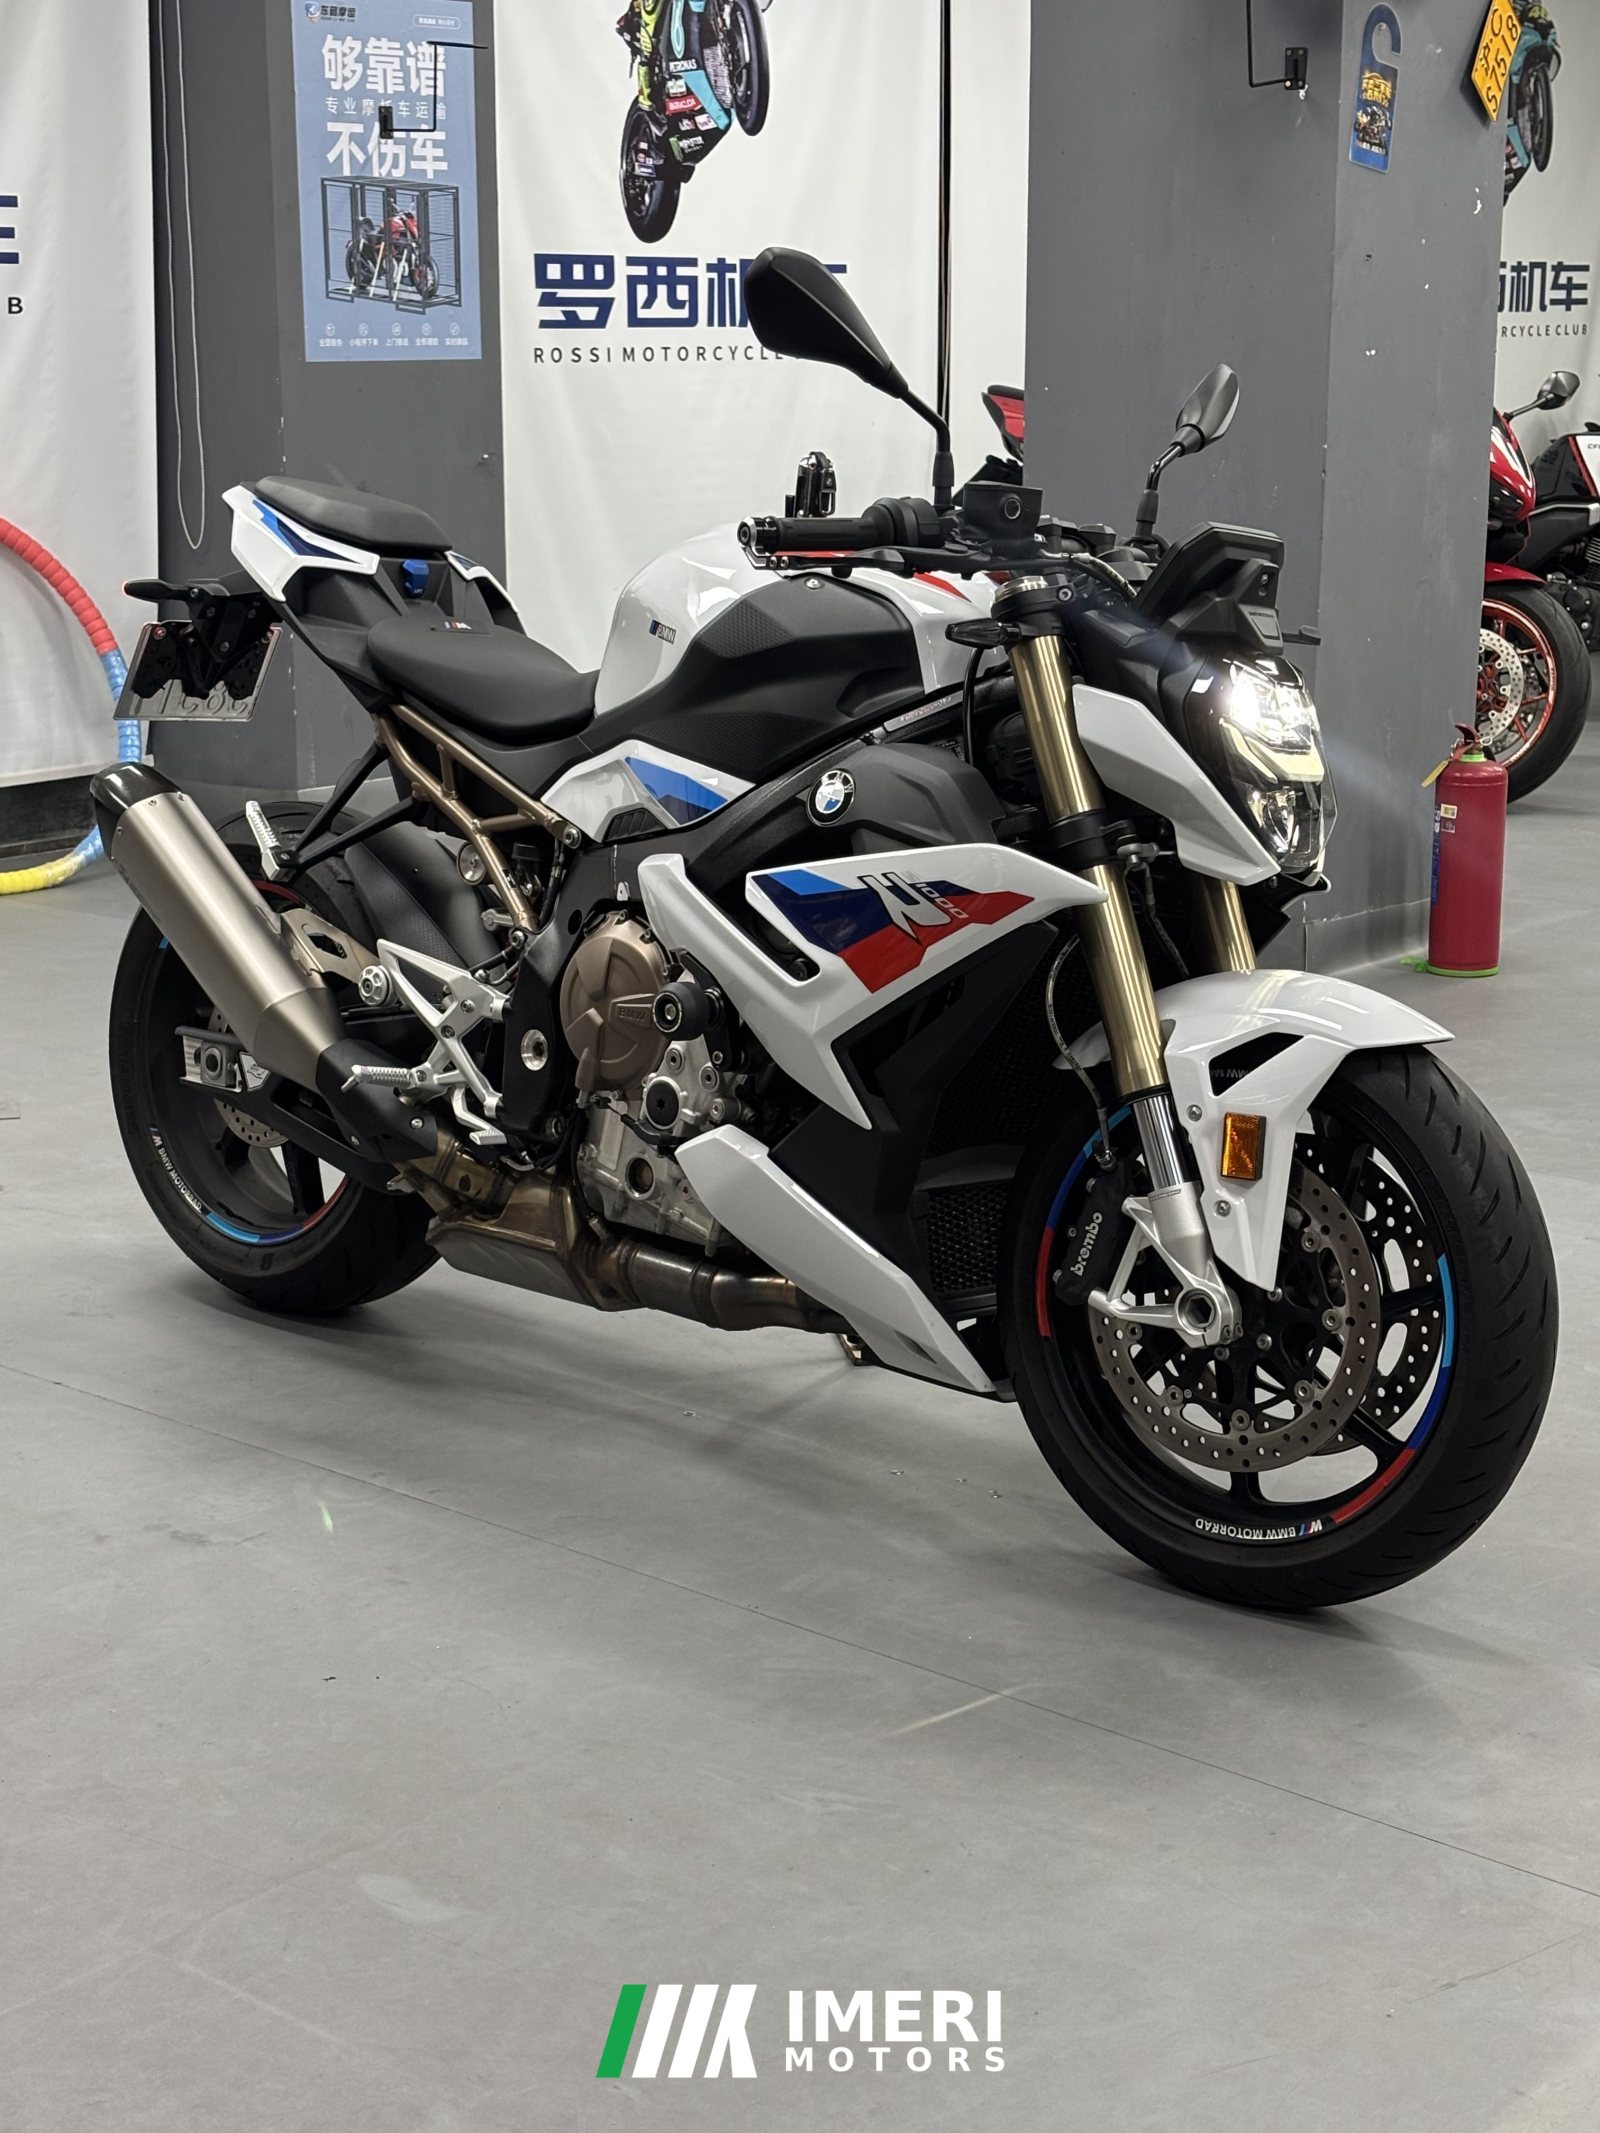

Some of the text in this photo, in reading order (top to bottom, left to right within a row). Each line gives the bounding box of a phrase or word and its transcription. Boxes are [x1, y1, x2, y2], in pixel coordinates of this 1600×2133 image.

[322, 35, 447, 97] 够靠谱
[326, 96, 447, 120] 专业摩车运输
[326, 121, 448, 179] 不伤车
[533, 253, 847, 329] 罗西机
[1501, 323, 1588, 338] RCYCLE CLUB
[534, 347, 612, 364] ROSSI
[1070, 1212, 1103, 1276] brembo
[1195, 1518, 1263, 1540] MOTORRAD
[1266, 1526, 1297, 1540] BMW
